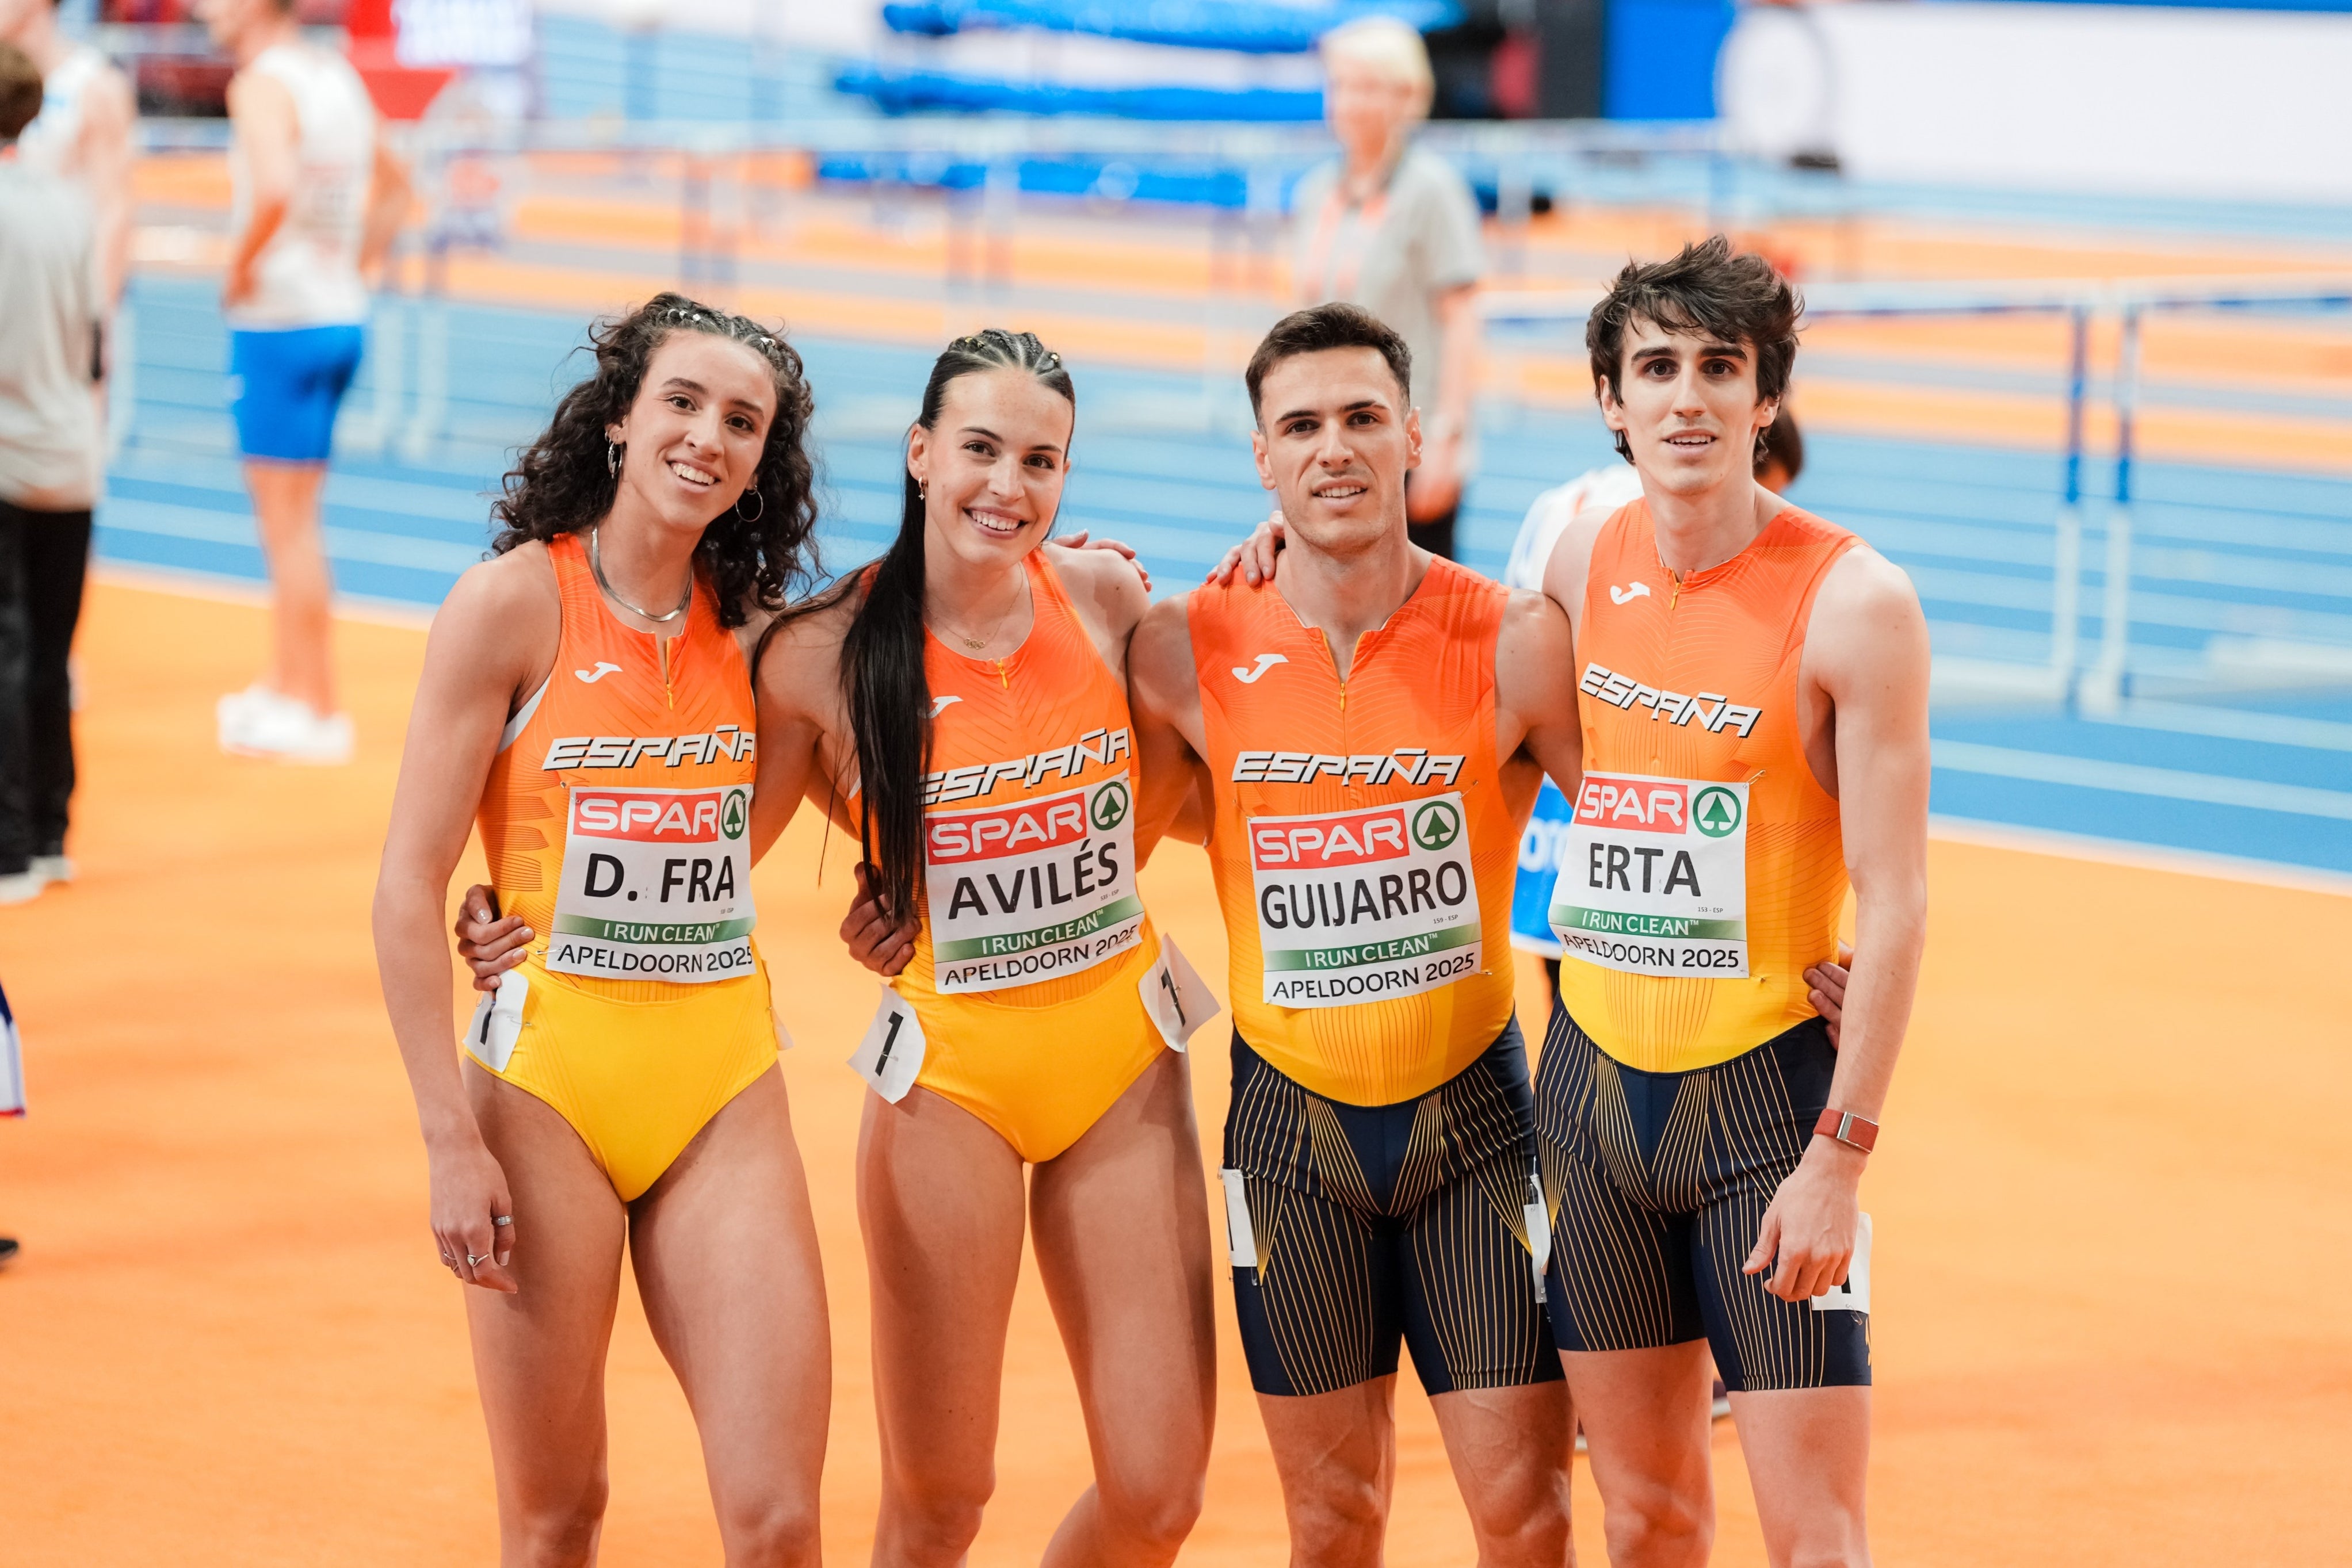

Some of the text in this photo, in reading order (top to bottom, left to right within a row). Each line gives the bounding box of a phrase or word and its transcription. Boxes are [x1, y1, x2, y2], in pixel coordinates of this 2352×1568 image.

[1579, 661, 1763, 739] ESPAÑA
[541, 725, 756, 771] ESPAÑA
[1231, 748, 1466, 786] ESPAÑA
[579, 798, 717, 836] SPAR
[1579, 783, 1683, 826] SPAR
[931, 801, 1084, 858] SPAR
[1255, 817, 1404, 863] SPAR
[583, 852, 734, 904] D. FRA
[948, 838, 1118, 920] AVILÉS
[1589, 842, 1701, 897] ERTA
[1260, 861, 1468, 931] GUIJARRO
[604, 922, 609, 937] I
[614, 923, 658, 942] RUN
[982, 939, 988, 955] I
[992, 932, 1036, 954] RUN
[1582, 911, 1588, 926] I
[1589, 912, 1622, 932] RUN
[557, 944, 702, 973] APELDOORN
[944, 944, 1089, 986] APELDOORN
[1305, 951, 1311, 967] I
[1314, 949, 1358, 968] RUN
[1563, 934, 1739, 968] APELDOORN 2025
[1160, 966, 1186, 1027] 1
[1273, 952, 1475, 999] APELDOORN 2025
[875, 1011, 904, 1077] 1
